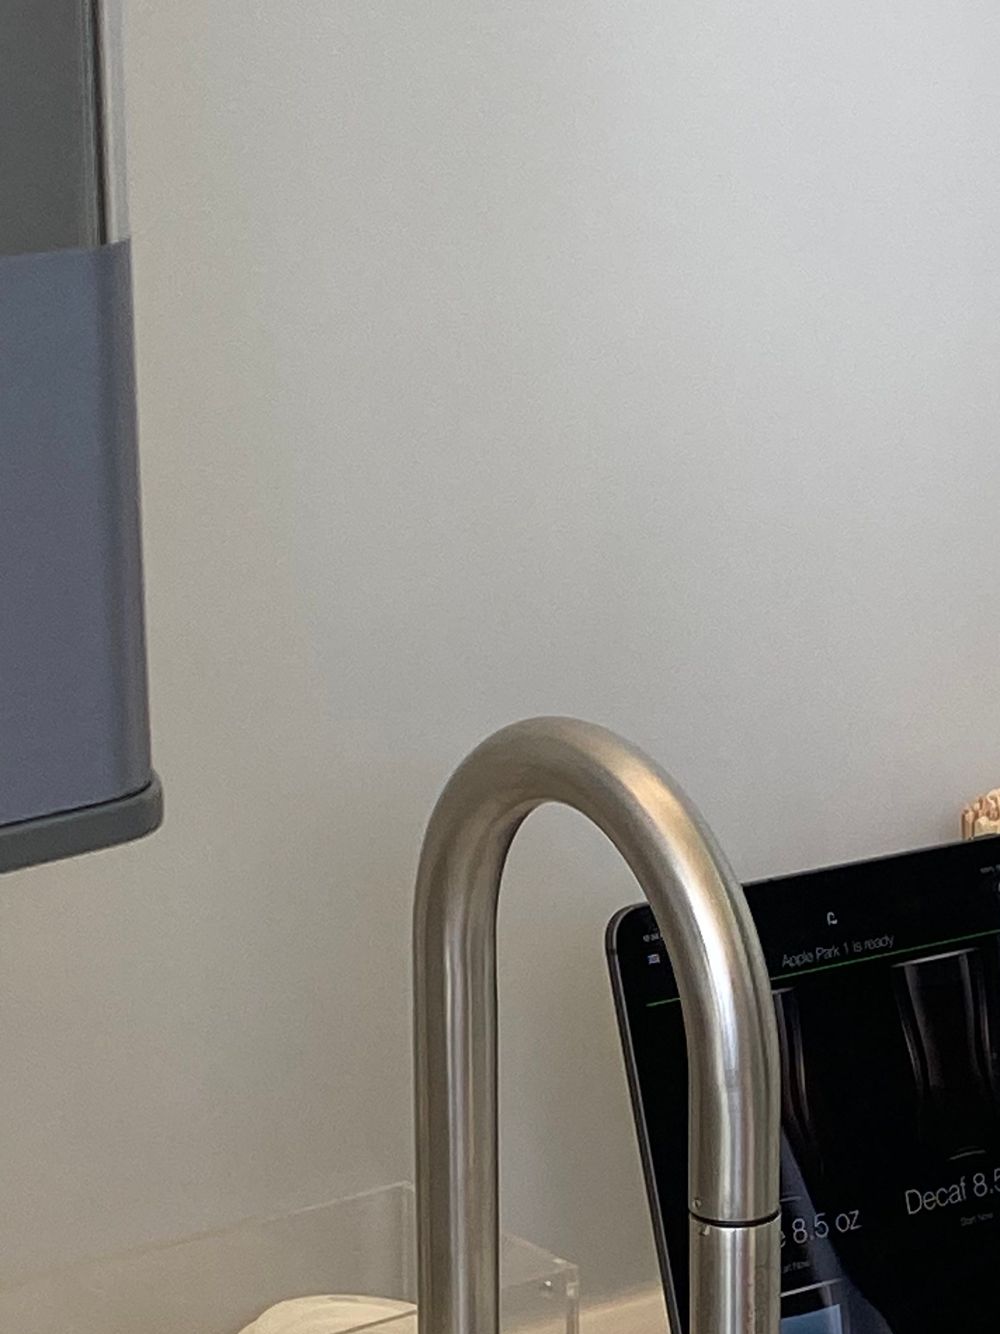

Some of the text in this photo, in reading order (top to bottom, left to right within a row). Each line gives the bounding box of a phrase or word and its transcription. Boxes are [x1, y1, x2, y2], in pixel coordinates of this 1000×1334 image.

[782, 949, 814, 968] Apple
[815, 944, 840, 960] Park
[852, 940, 862, 953] is
[864, 934, 895, 950] ready
[904, 1176, 967, 1215] Decaf
[791, 1212, 830, 1244] 8.5
[835, 1209, 862, 1233] oz
